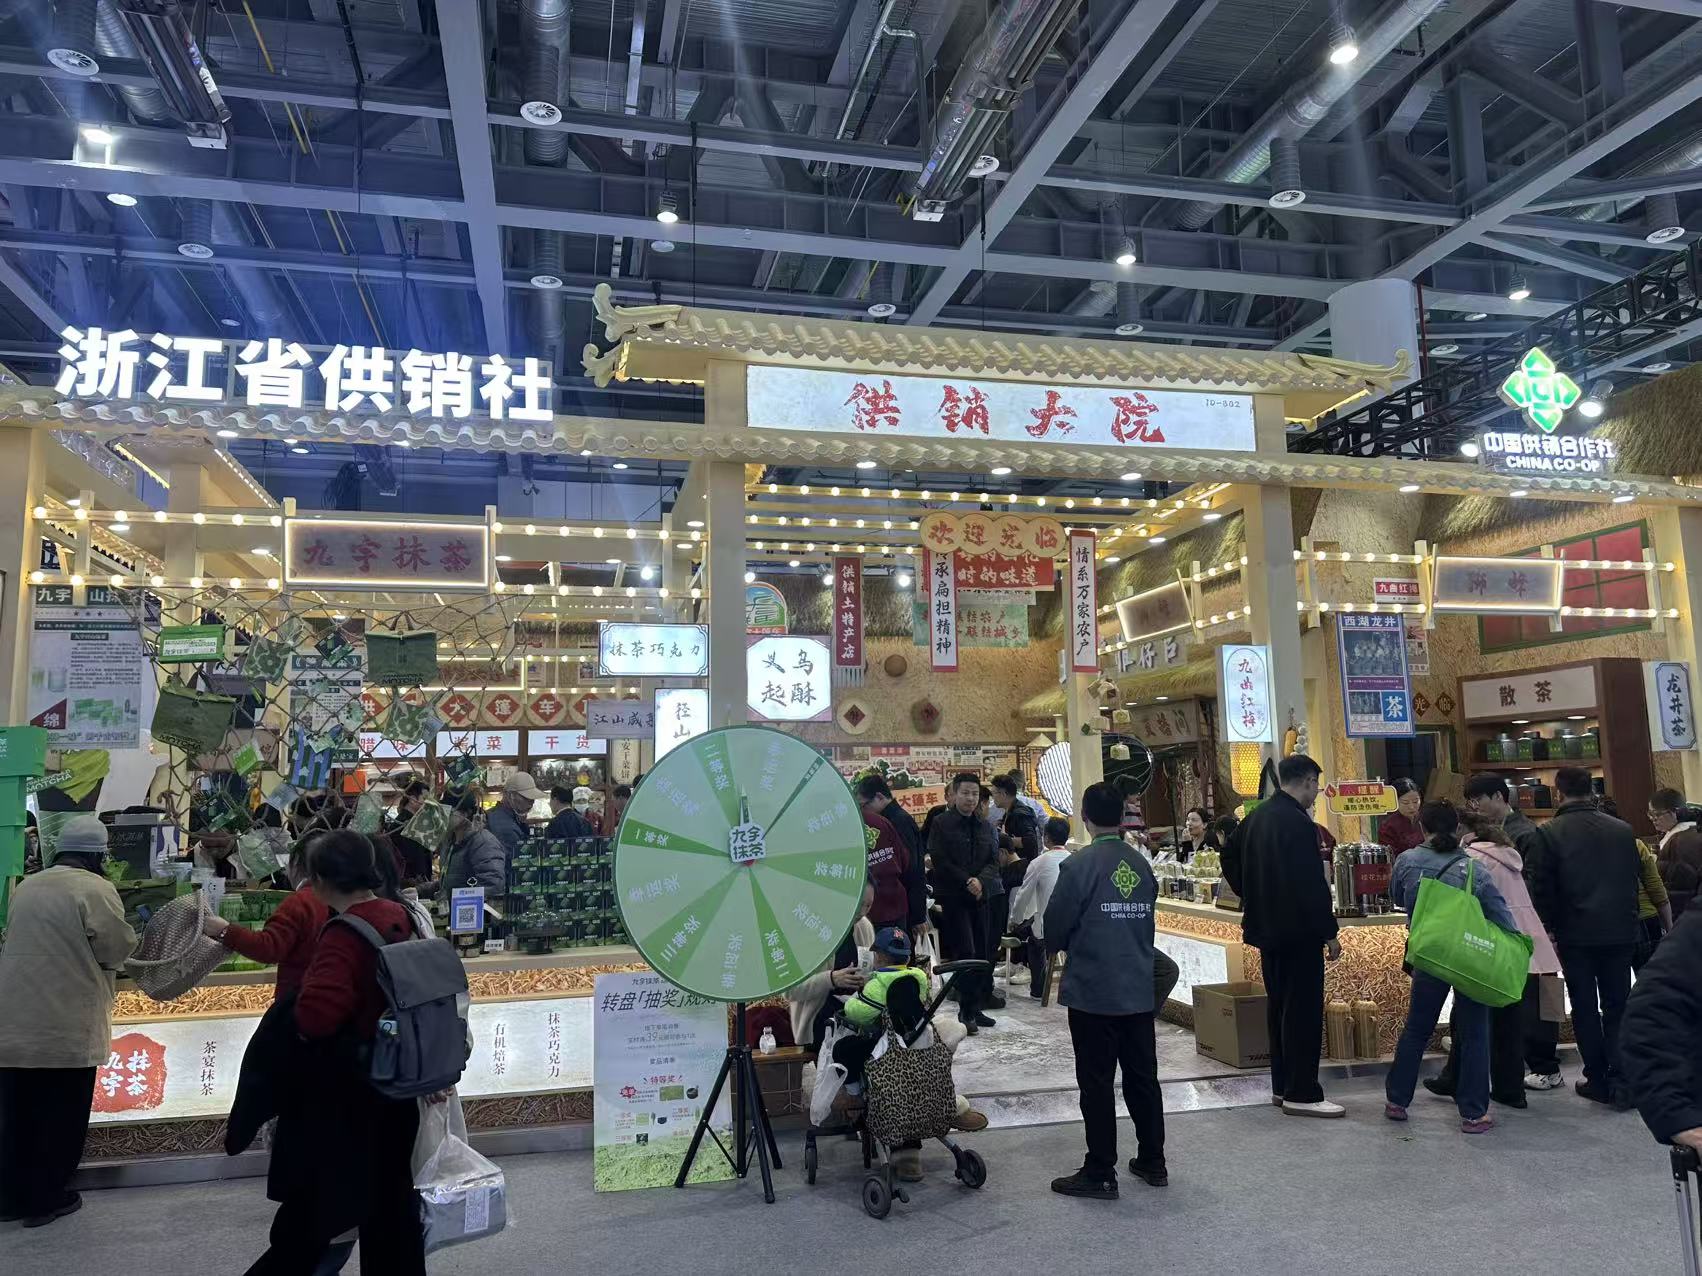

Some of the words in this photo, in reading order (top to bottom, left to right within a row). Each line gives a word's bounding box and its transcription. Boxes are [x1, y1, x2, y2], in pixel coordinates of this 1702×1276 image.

[54, 325, 554, 421] 浙江省供销社
[845, 378, 1164, 444] 供销大院
[1484, 432, 1616, 458] 中国供销合作社
[1506, 455, 1553, 470] CHINA
[1554, 457, 1600, 472] CO-OP
[928, 520, 1058, 549] 欢迎光临
[841, 564, 856, 659] 供销土特产店
[1075, 547, 1091, 656] 情系万家农户
[1342, 615, 1396, 628] 西湖龙井
[609, 640, 700, 657] 抹茶巧克力
[762, 649, 814, 676] 义乌
[761, 680, 817, 707] 起酥
[1238, 658, 1257, 728] 九曲红梅
[1385, 695, 1403, 718] 茶
[1499, 680, 1552, 707] 散茶
[1666, 673, 1686, 736] 龙井茶
[673, 702, 691, 739] 径山
[545, 735, 589, 749] 干货
[814, 861, 857, 880] 三等奖
[1101, 902, 1151, 912] 中国供销合作社
[660, 915, 701, 963] 三等奖
[765, 931, 790, 978] 二等奖
[547, 1012, 561, 1078] 抹茶巧克力
[200, 1041, 216, 1096] 茶宴抹茶
